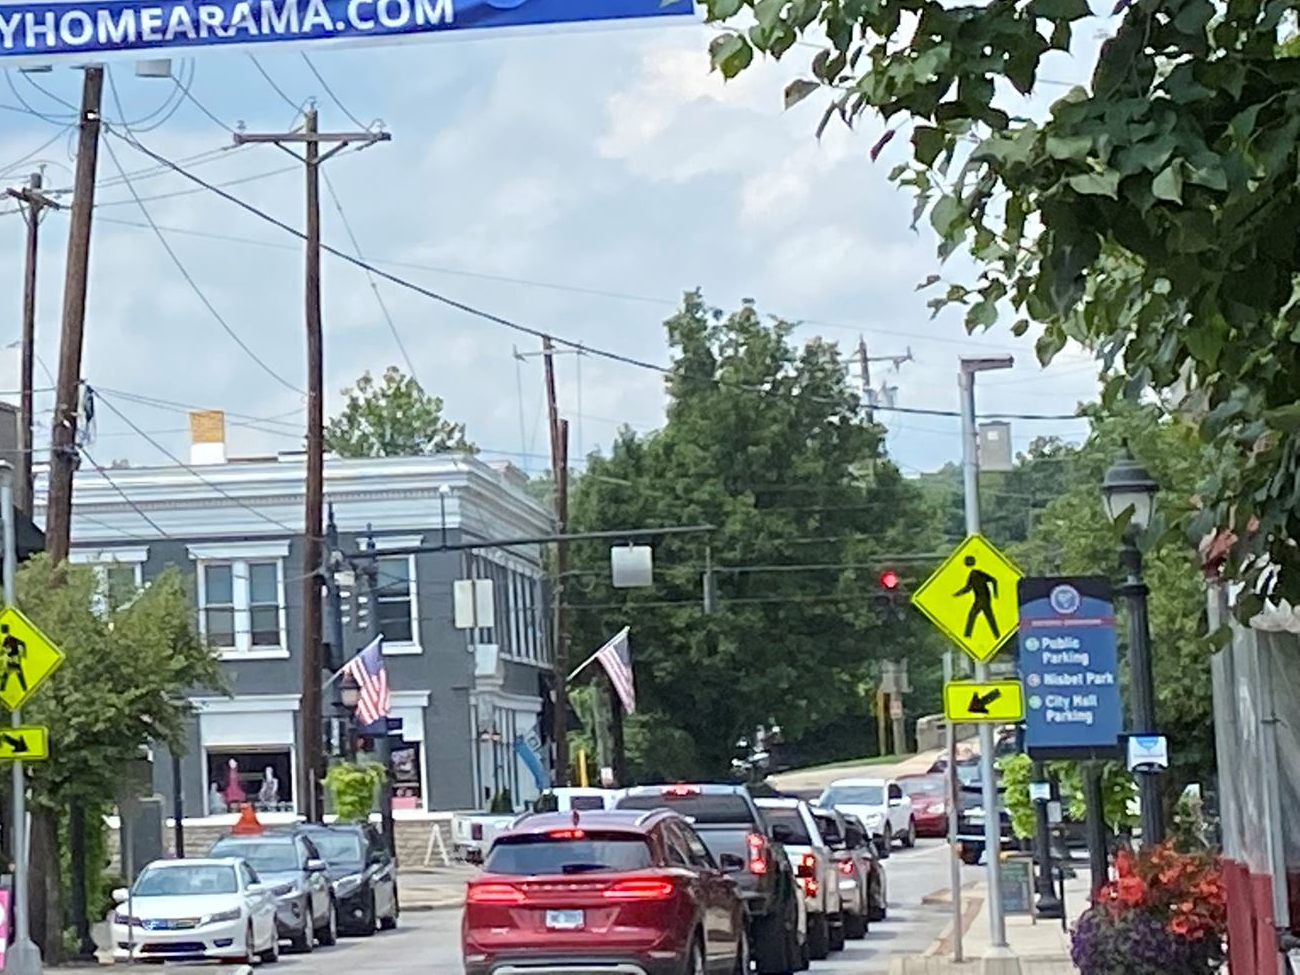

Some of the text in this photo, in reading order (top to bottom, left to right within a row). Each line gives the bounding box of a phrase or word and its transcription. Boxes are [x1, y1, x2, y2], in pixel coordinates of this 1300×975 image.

[1042, 637, 1080, 650] Public
[1042, 651, 1090, 666] Parking
[1086, 672, 1114, 685] Park
[1045, 695, 1098, 710] City Hall
[1046, 710, 1093, 725] Parking
